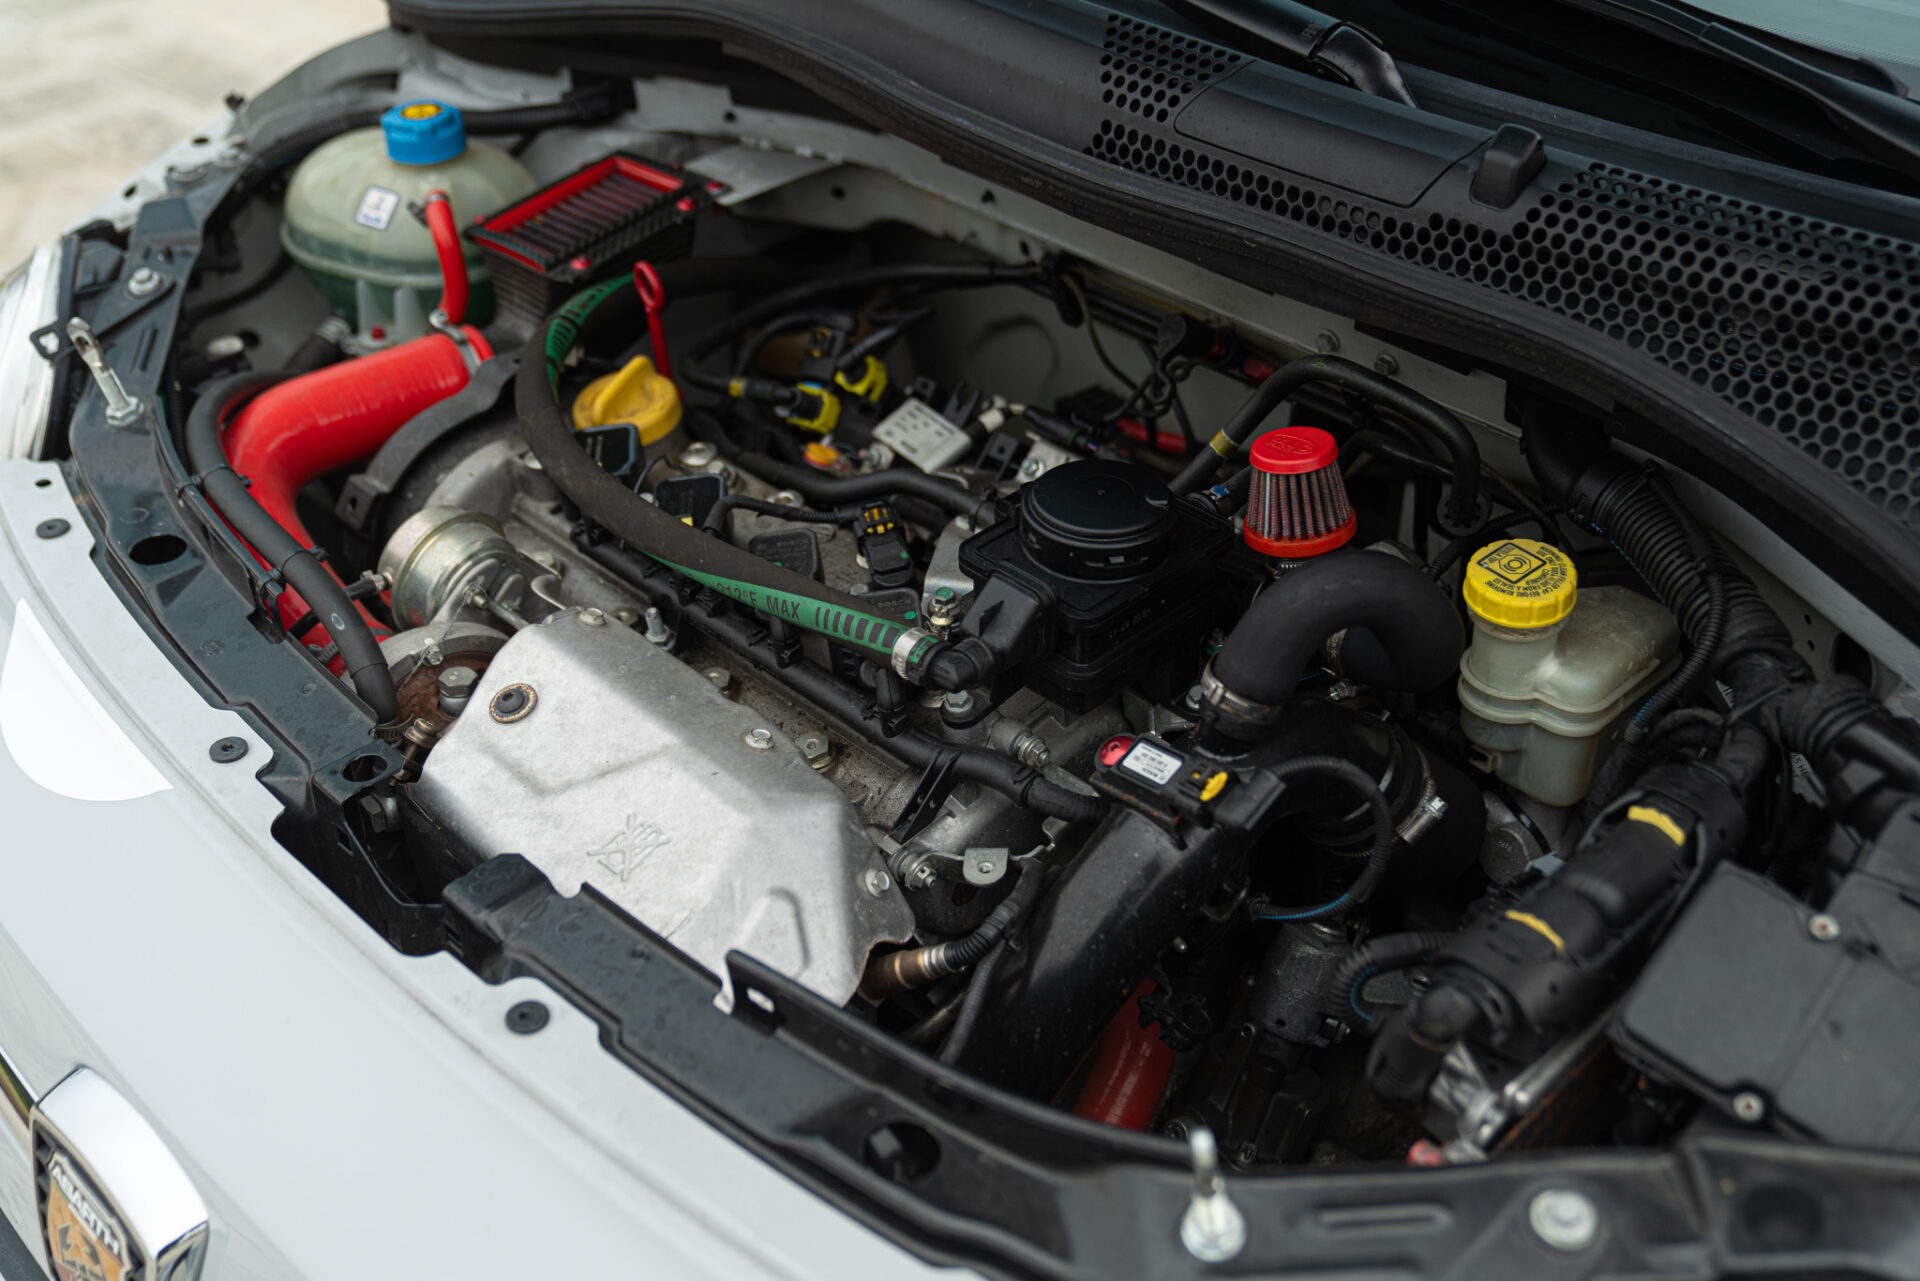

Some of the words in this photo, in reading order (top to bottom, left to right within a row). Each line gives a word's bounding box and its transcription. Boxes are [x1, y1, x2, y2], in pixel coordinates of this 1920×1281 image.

[1542, 587, 1553, 595] CAP
[766, 595, 800, 620] MAX
[51, 1165, 120, 1257] ABARTH
